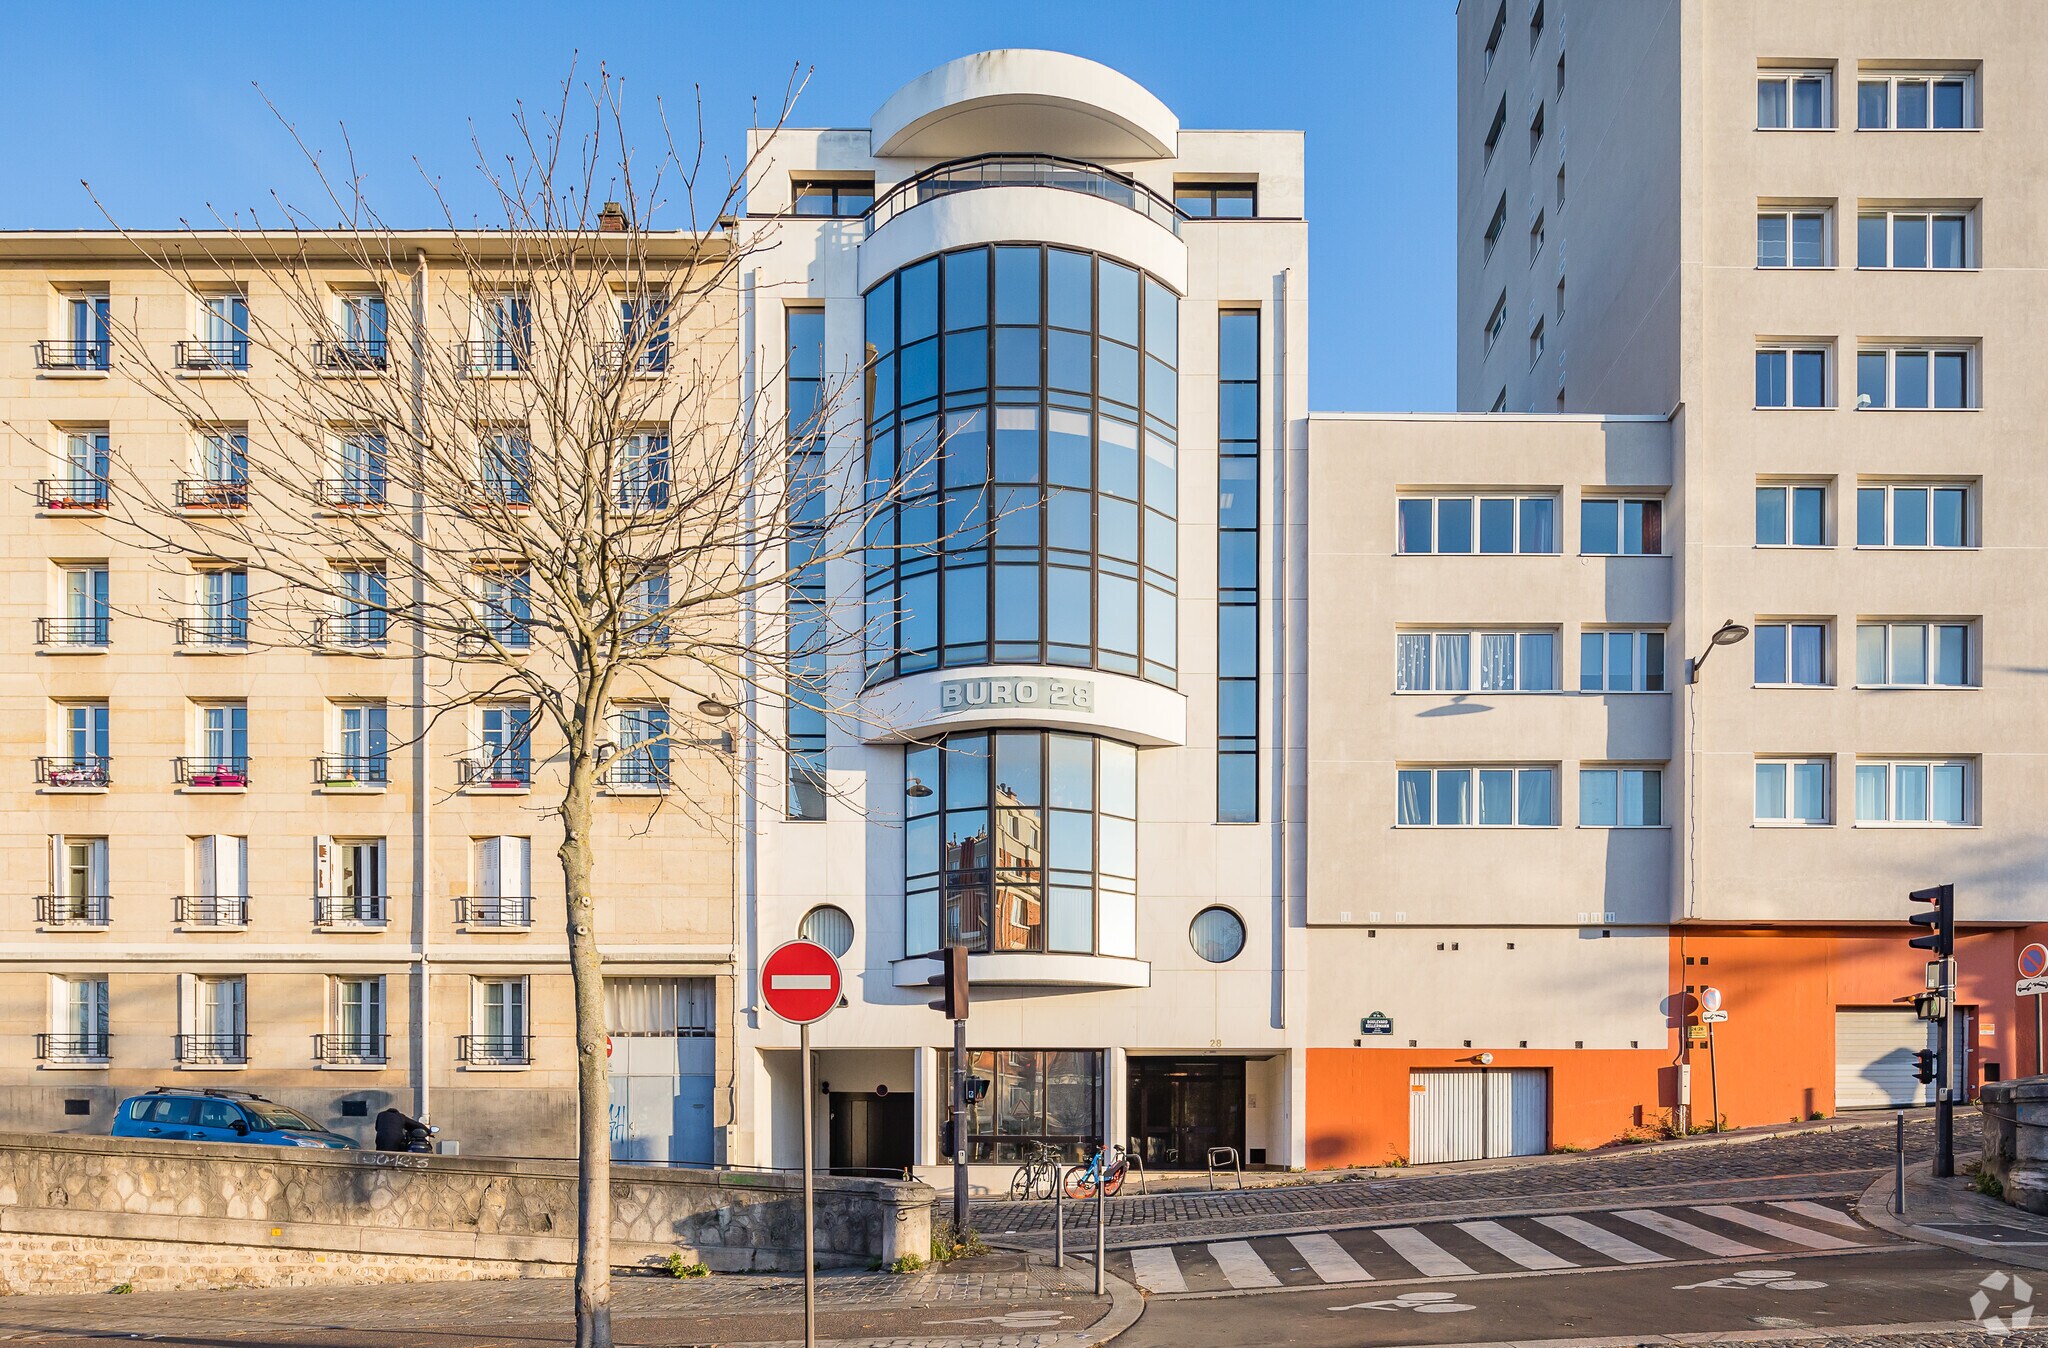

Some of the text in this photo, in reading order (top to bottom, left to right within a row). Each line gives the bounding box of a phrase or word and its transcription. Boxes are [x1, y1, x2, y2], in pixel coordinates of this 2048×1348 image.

[942, 680, 1092, 708] BURO 28
[1209, 1039, 1222, 1048] 28
